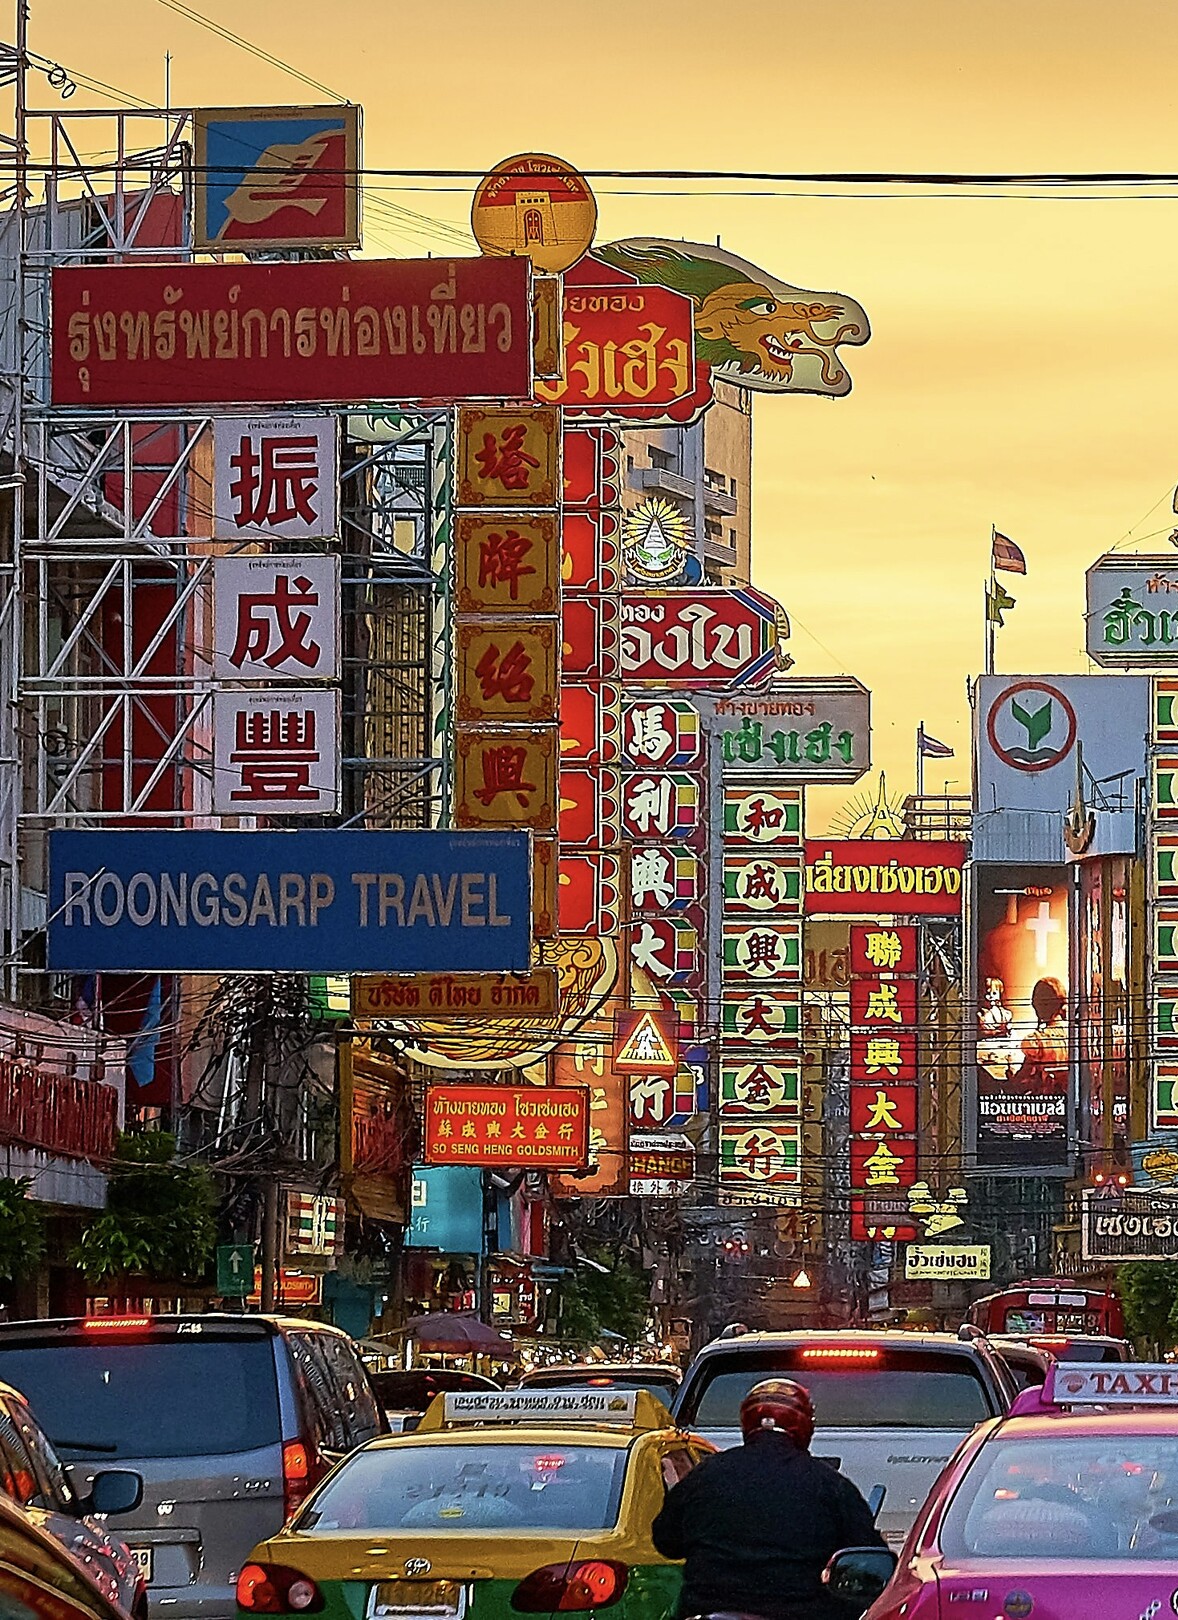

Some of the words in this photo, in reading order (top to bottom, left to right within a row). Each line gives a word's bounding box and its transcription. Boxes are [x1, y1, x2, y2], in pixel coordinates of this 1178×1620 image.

[68, 264, 513, 393] รุ่งทรัพย์การท่องเที่ยว
[230, 435, 322, 801] 振成豐
[473, 423, 541, 808] 塔牌紹興
[65, 872, 335, 927] ROONGSARP
[351, 872, 512, 927] TRAVEL
[805, 851, 961, 894] เลี่ยงเซ่งเฮง
[739, 797, 786, 1175] 和成興大金行
[437, 1119, 575, 1141] 蘇成興大金行
[865, 931, 904, 1238] 聯成興大金
[432, 1143, 447, 1154] SO
[451, 1143, 479, 1154] SENG
[484, 1144, 513, 1155] HENG
[516, 1144, 579, 1156] GOLDSMITH
